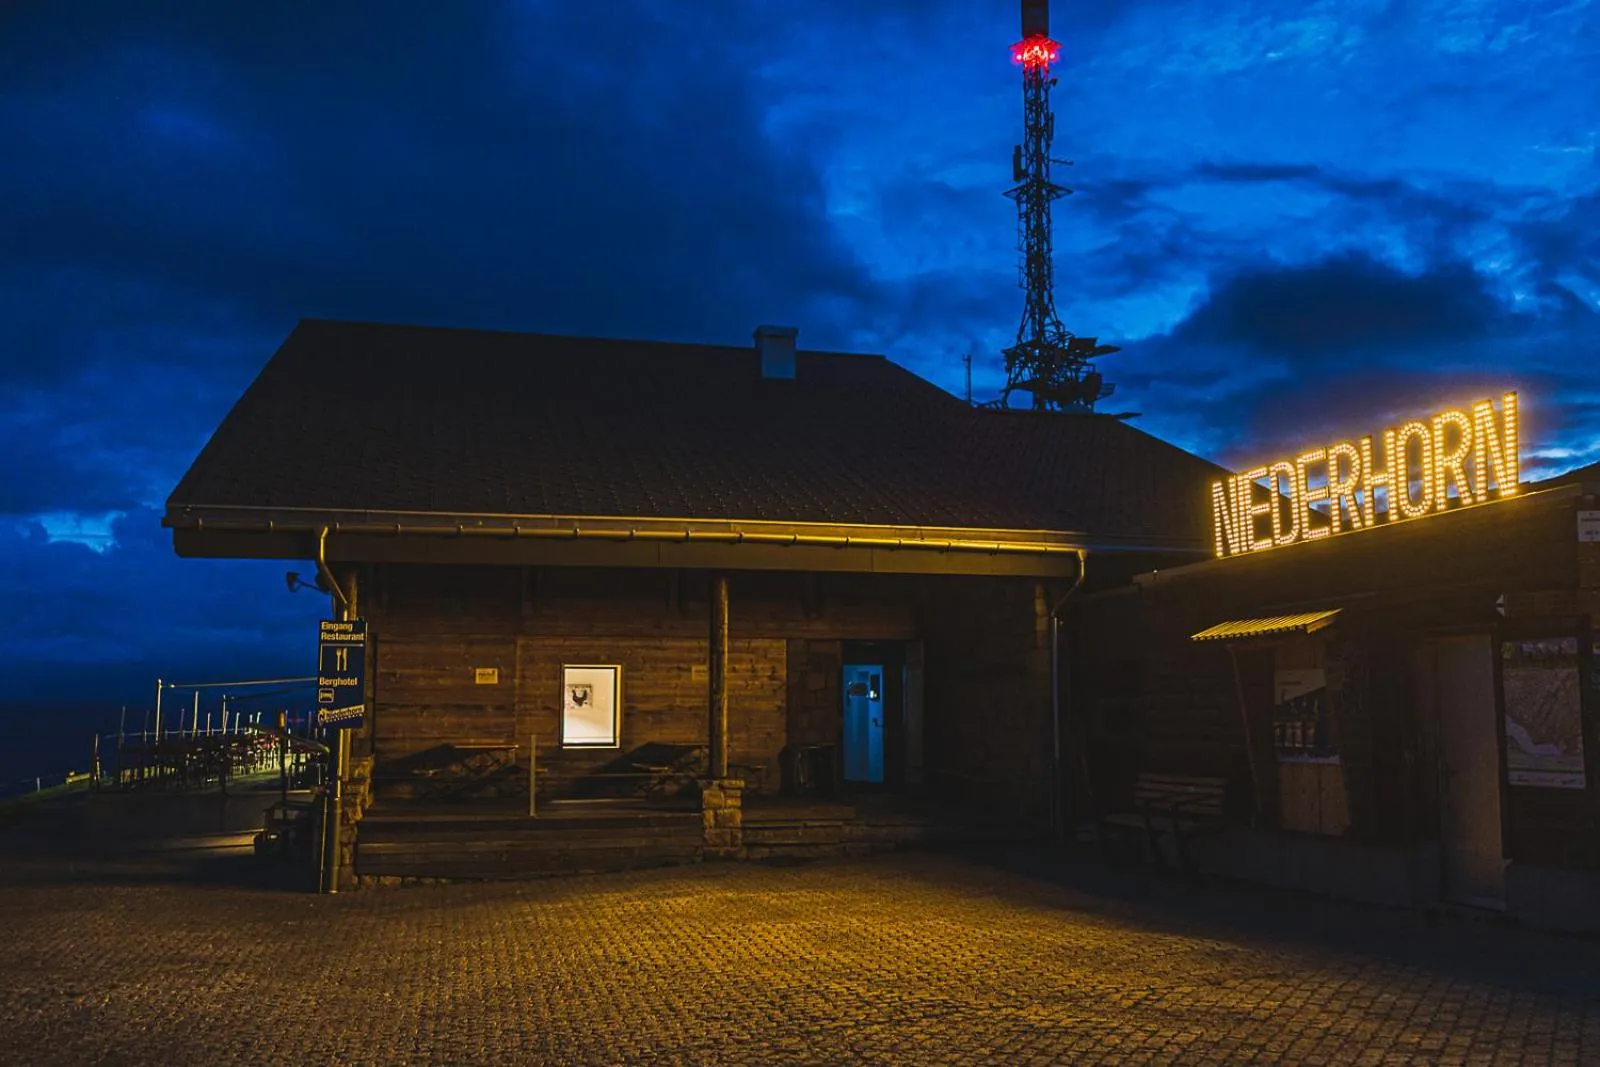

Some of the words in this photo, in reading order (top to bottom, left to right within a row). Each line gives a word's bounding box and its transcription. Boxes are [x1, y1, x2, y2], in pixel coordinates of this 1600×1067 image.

[1212, 391, 1519, 558] NIEDERHORN
[321, 621, 353, 631] Eingang
[321, 632, 365, 641] Restaurant
[319, 677, 358, 687] Berghotel
